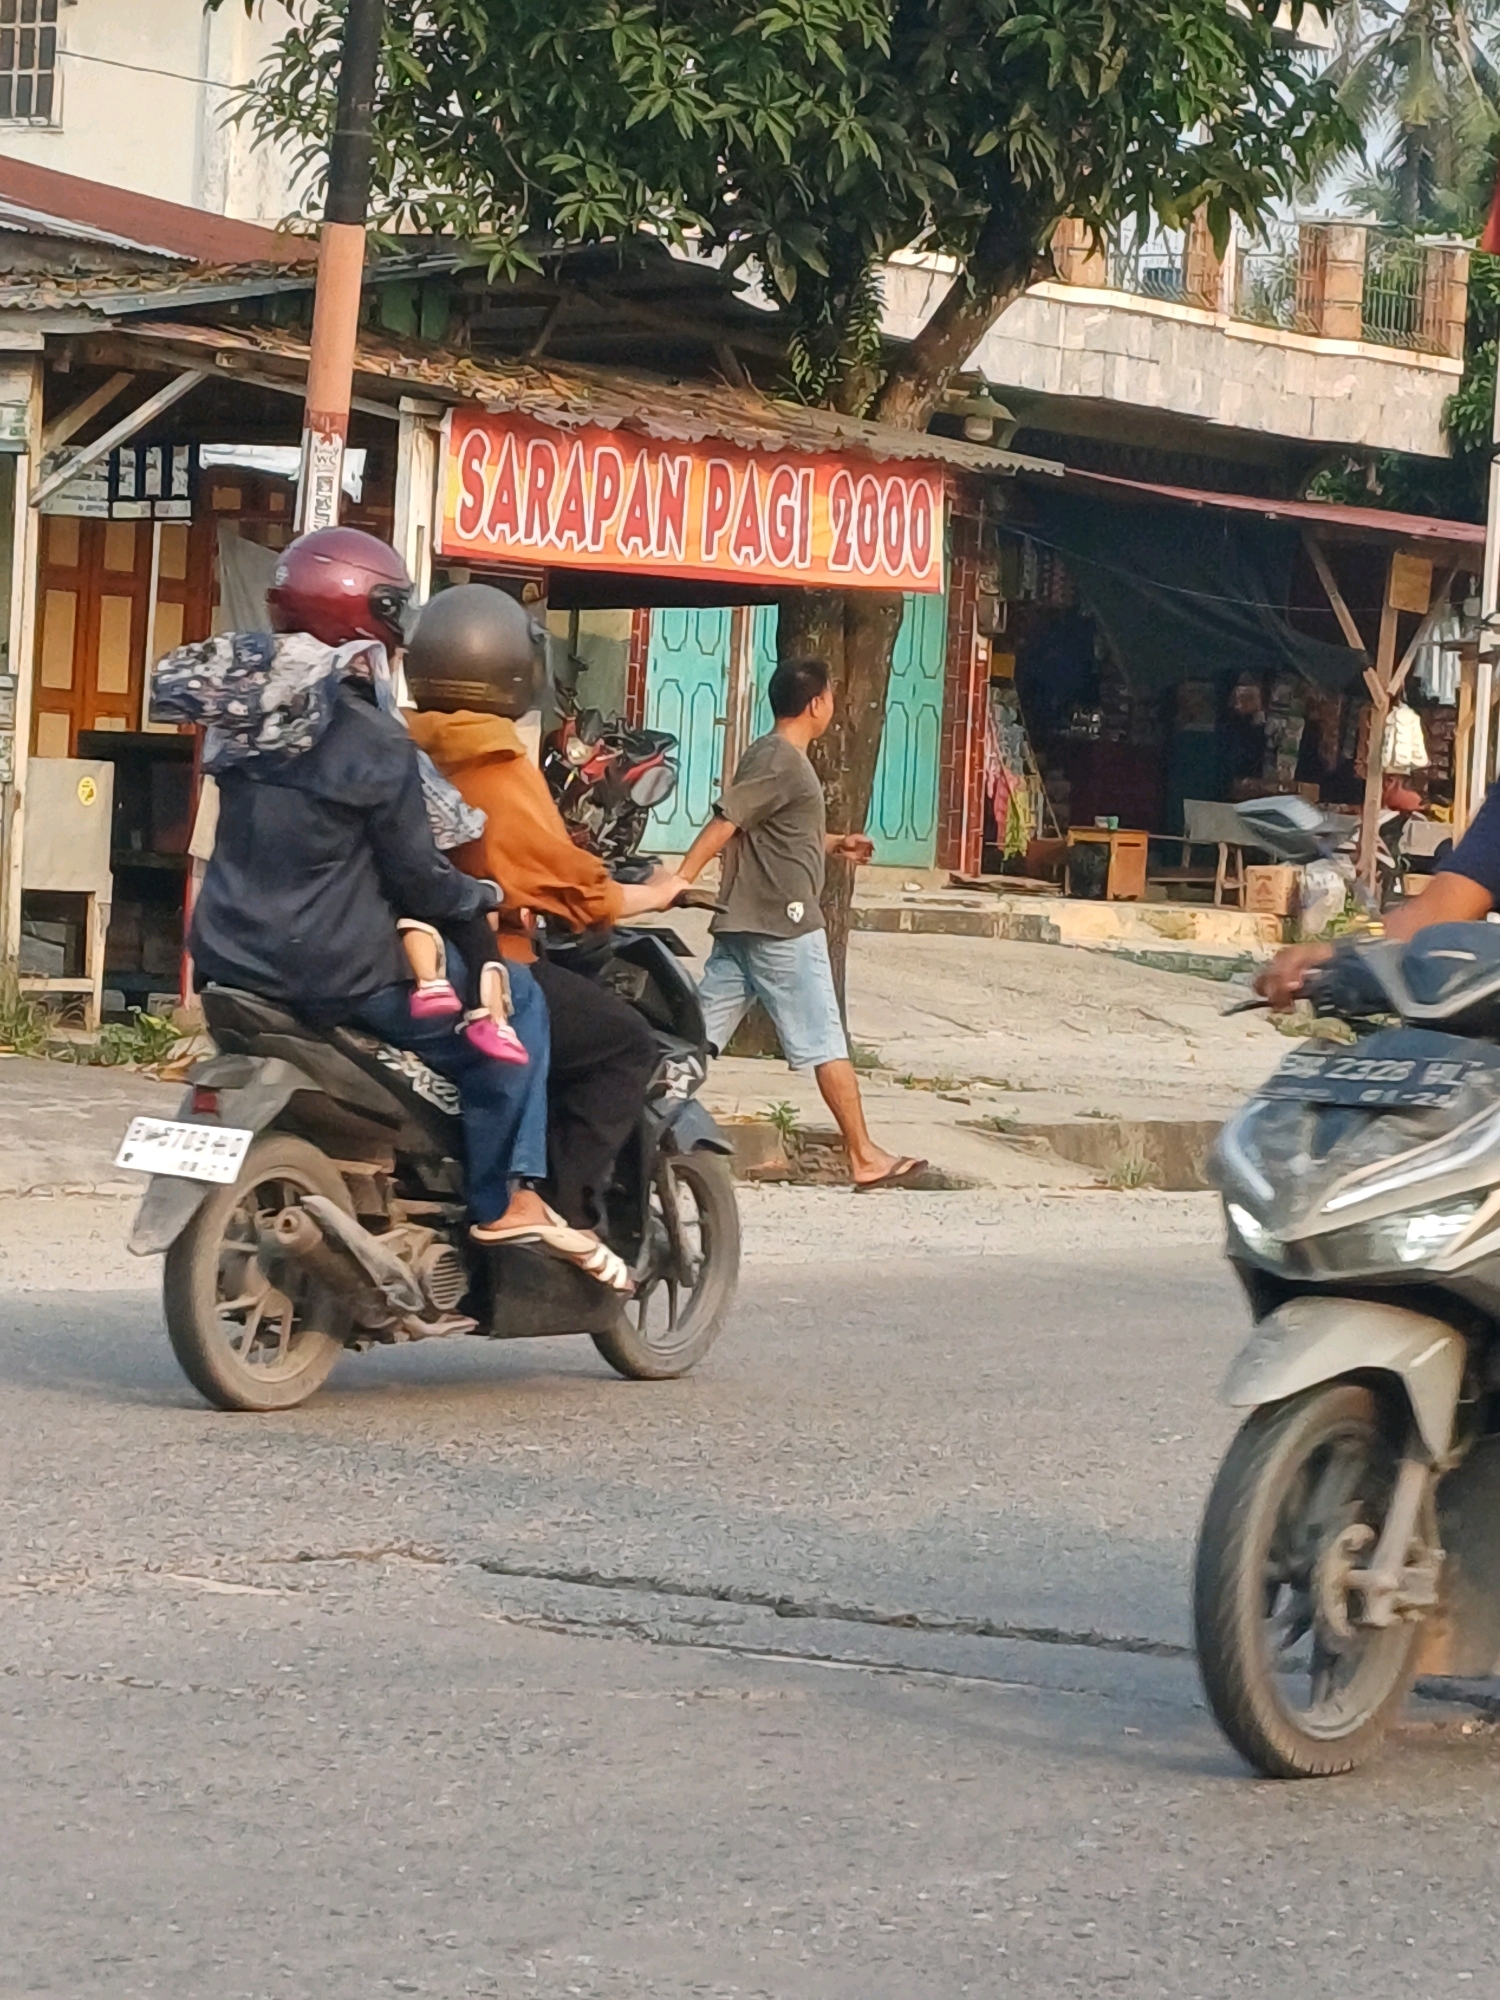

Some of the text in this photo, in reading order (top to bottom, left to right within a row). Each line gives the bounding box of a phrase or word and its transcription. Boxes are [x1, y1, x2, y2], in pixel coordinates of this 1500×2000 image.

[455, 428, 692, 561] SARAPAN
[702, 457, 816, 569] PAGI
[828, 468, 935, 578] 2000
